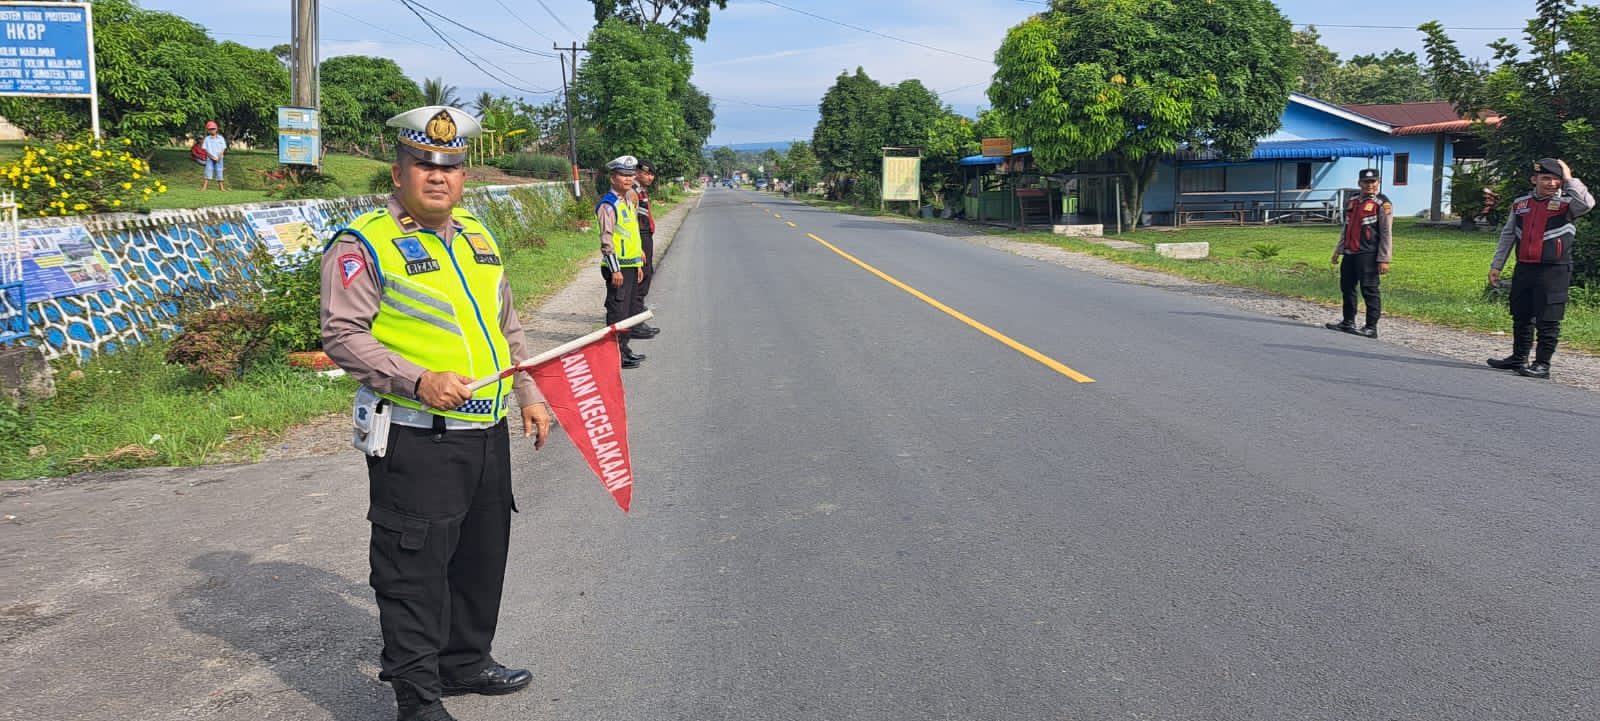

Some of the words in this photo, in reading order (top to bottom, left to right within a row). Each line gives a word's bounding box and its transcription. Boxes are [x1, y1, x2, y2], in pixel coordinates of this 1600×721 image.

[44, 11, 82, 22] PROTESTAN
[6, 23, 46, 41] HKBP
[407, 260, 439, 274] RIZAL
[577, 395, 633, 492] KECELAKAAN
